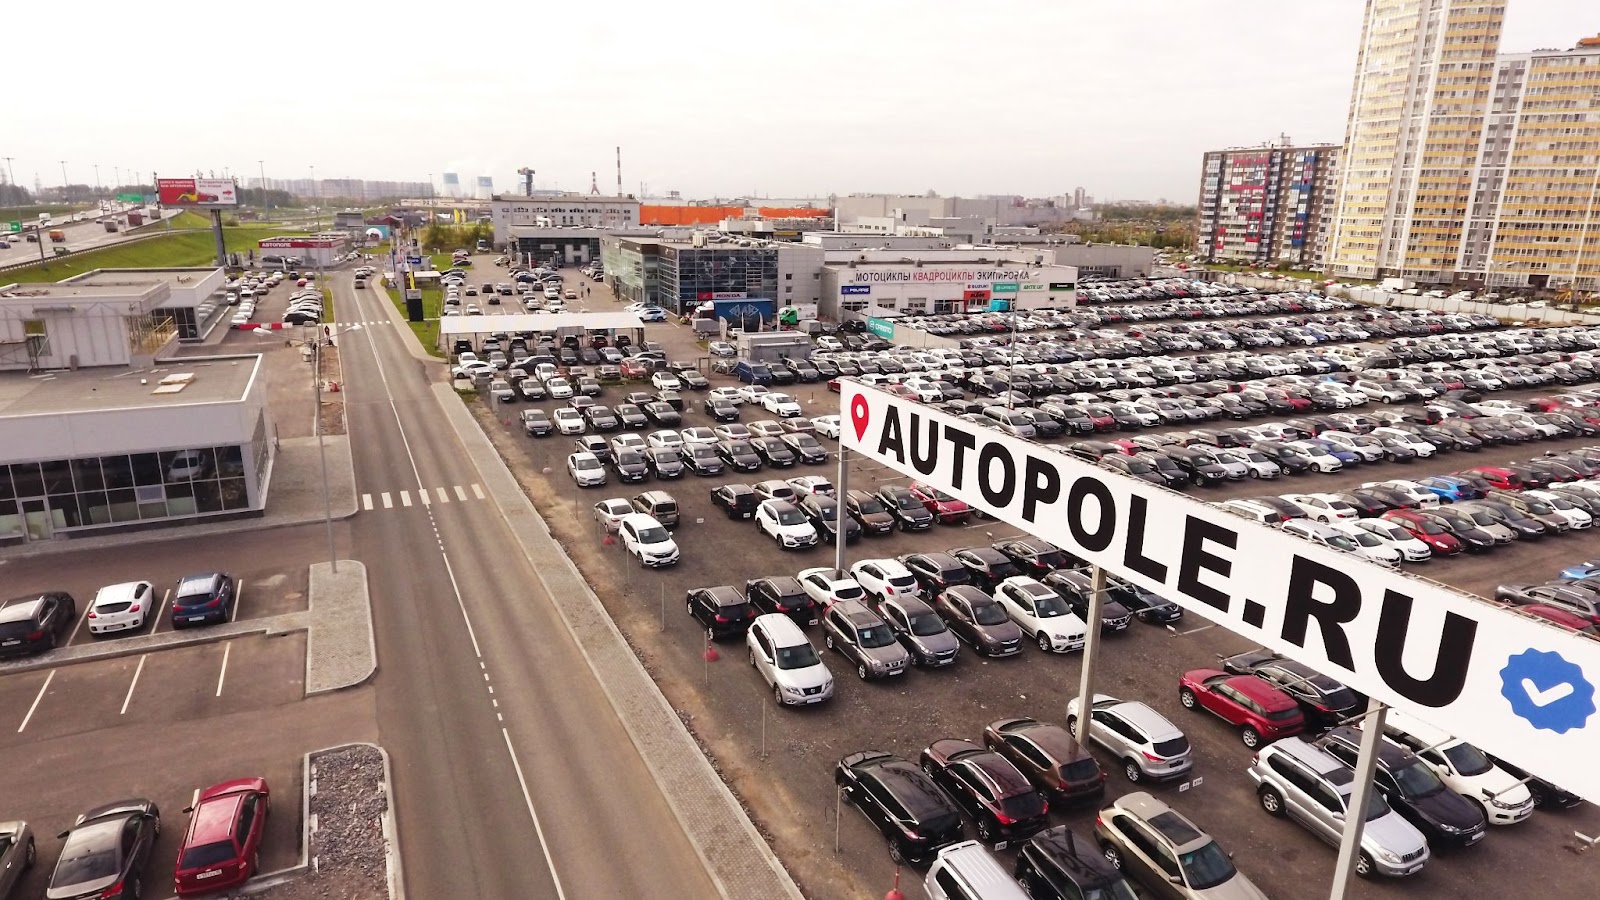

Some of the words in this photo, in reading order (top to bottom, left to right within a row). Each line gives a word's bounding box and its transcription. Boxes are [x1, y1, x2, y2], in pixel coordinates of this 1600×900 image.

[856, 272, 911, 282] МОТОЦИКЛЫ
[913, 271, 975, 282] КВАДРОЦИКЛЫ
[977, 270, 1030, 281] ЭКИПИРОВКА
[877, 404, 1479, 708] AUTOPOLE.RU
